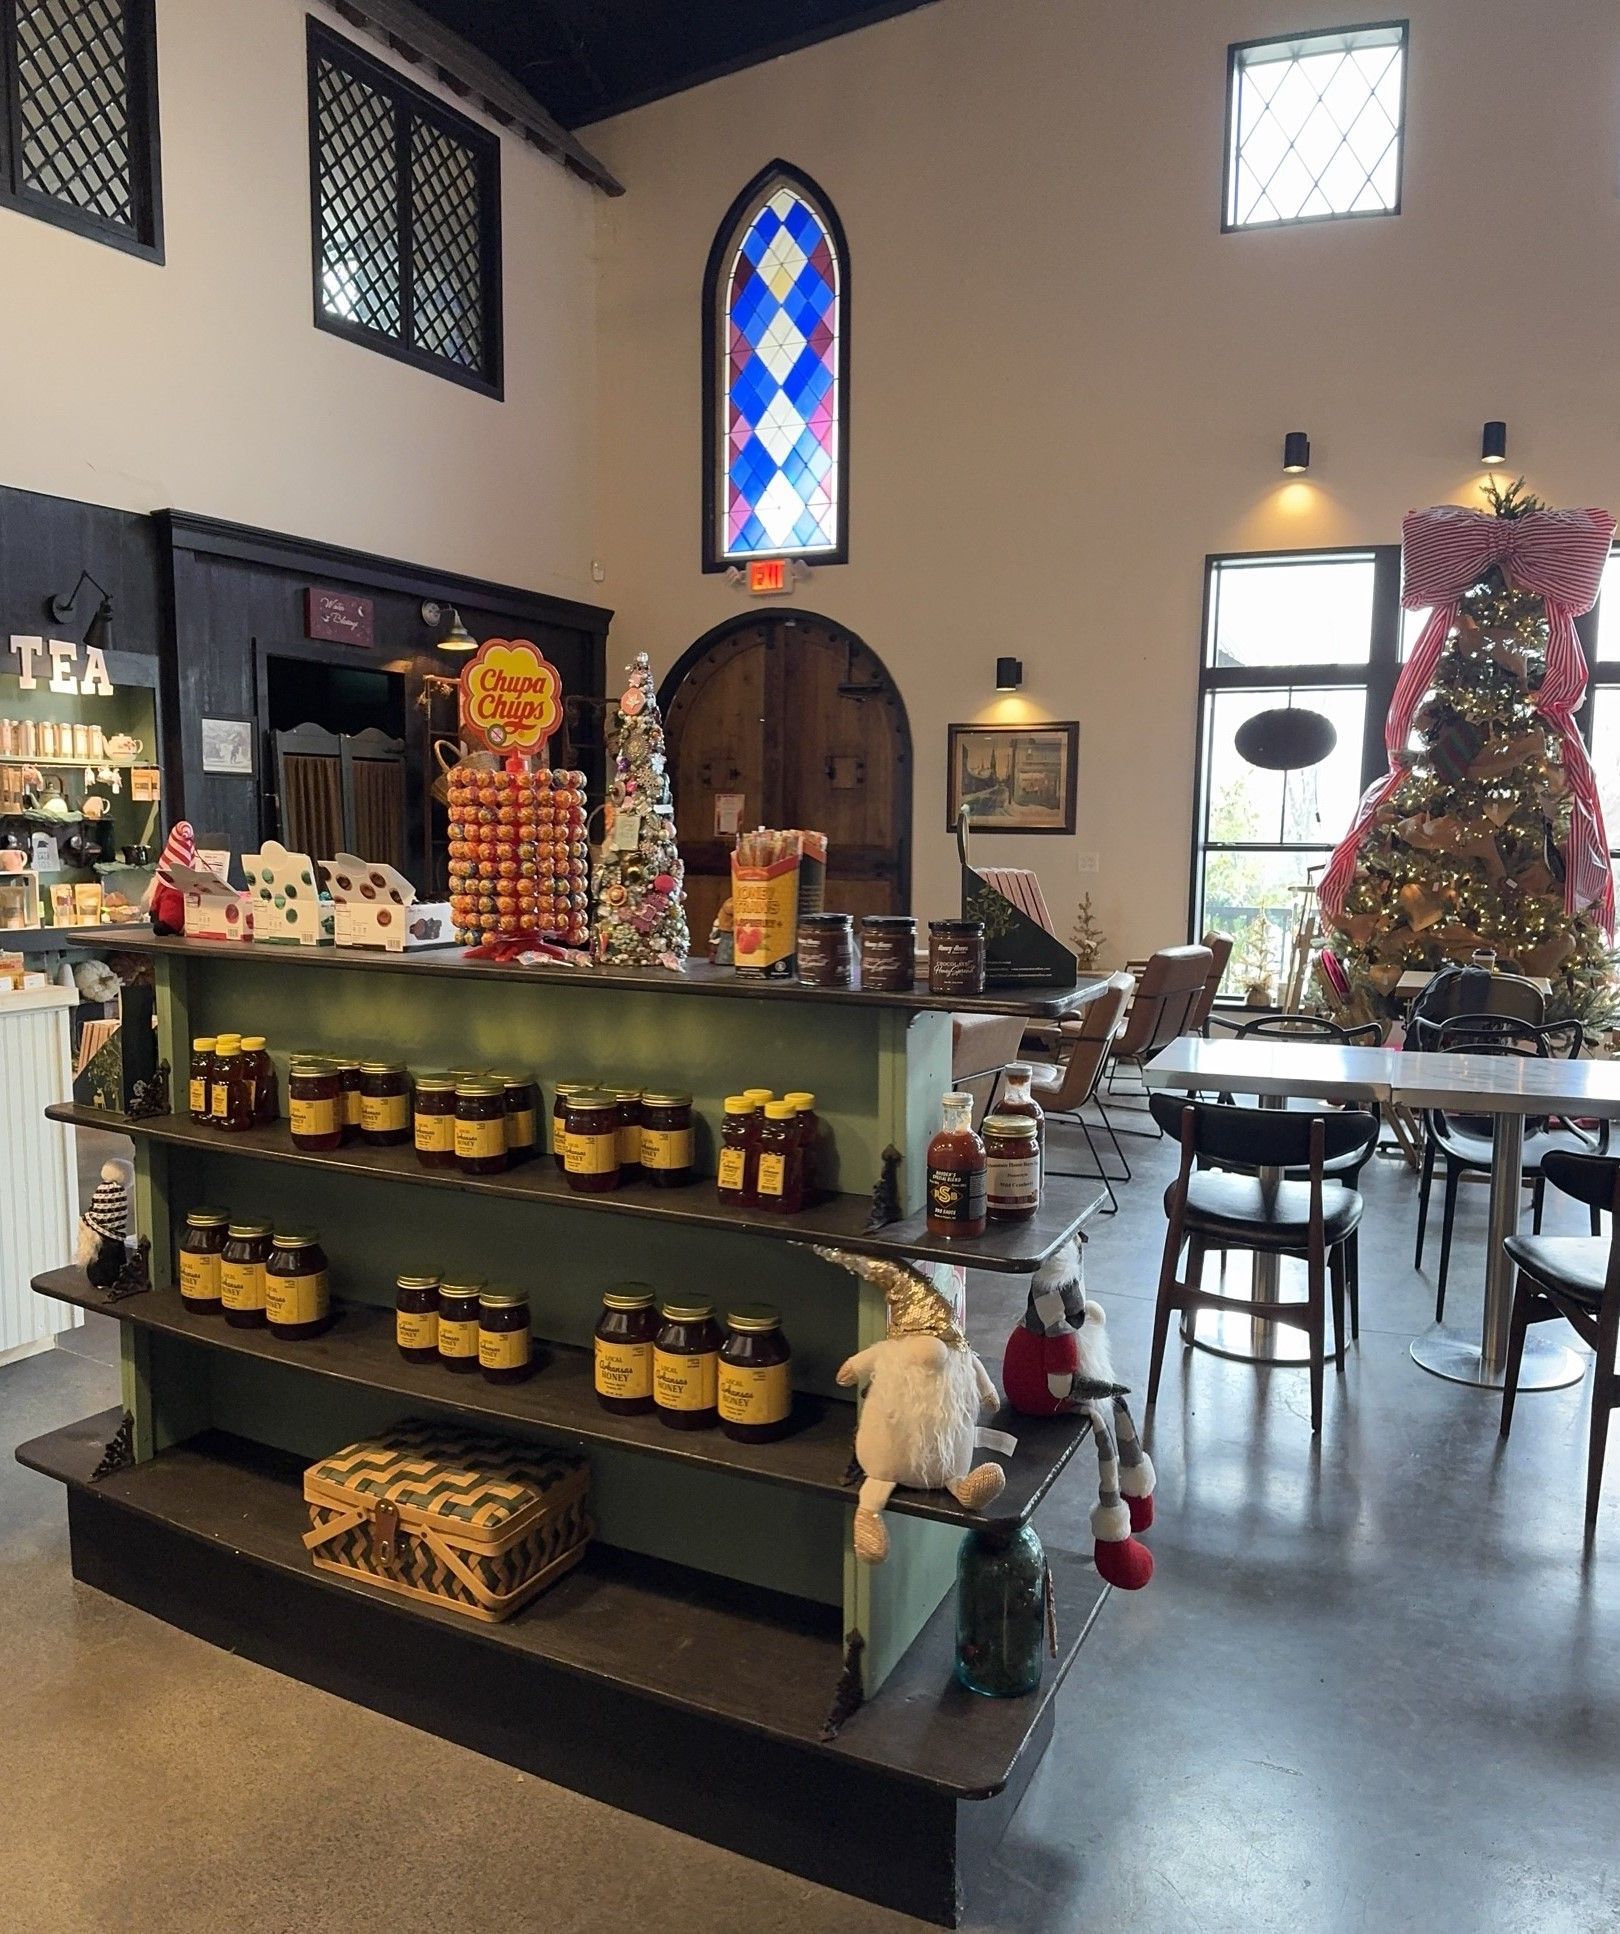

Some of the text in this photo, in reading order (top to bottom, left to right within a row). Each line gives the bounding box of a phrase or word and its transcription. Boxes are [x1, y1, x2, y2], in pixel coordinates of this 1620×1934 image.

[754, 563, 784, 588] EXIT
[10, 635, 113, 695] TEA
[480, 669, 546, 699] Chupa
[478, 694, 544, 731] Chups
